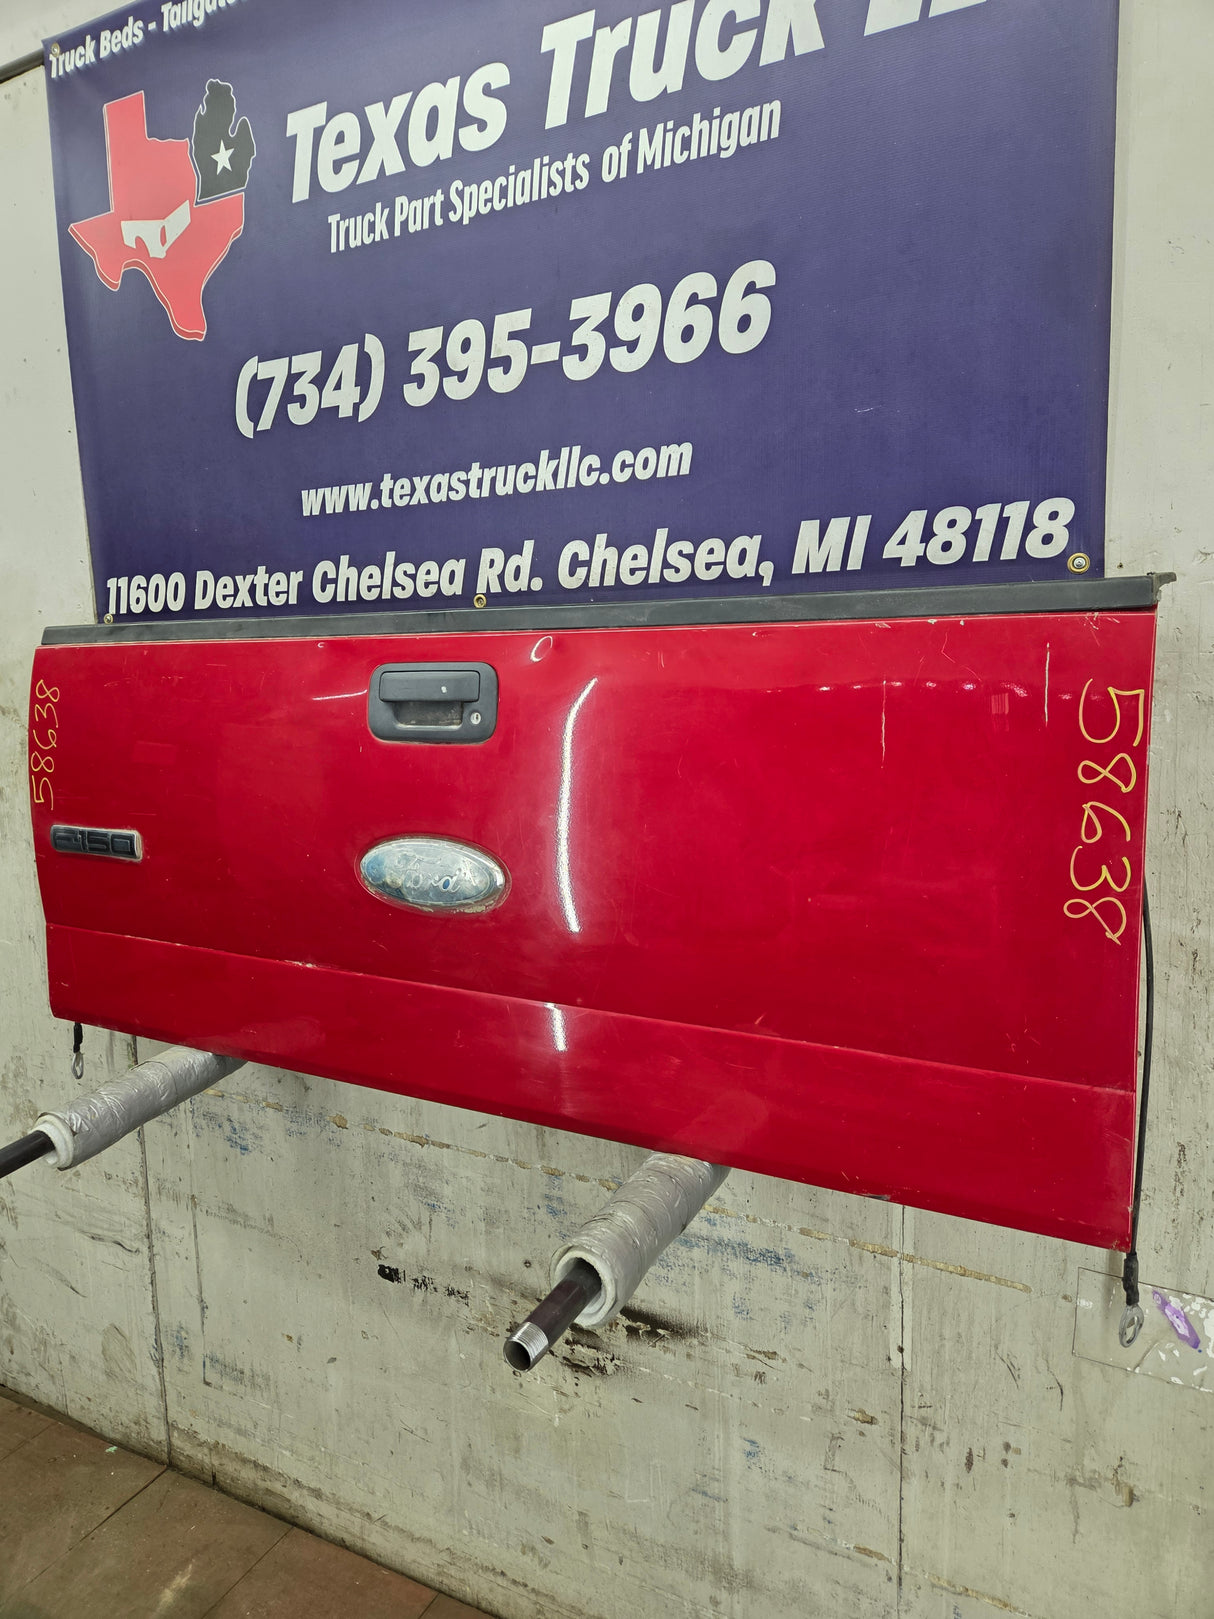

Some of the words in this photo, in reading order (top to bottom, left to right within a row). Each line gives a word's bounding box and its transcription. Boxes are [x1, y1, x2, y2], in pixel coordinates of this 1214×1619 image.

[49, 35, 97, 79] Truck
[100, 16, 143, 58] Beds
[286, 62, 510, 203] Texas
[540, 0, 825, 130] Truck
[328, 201, 389, 253] Truck
[394, 188, 444, 238] Part
[448, 153, 590, 225] Specialists
[602, 131, 632, 182] of
[637, 100, 781, 174] Michigan
[236, 333, 385, 438] (734)
[404, 260, 776, 406] 395-3966
[302, 442, 692, 516] www.texastruckllc.com
[107, 571, 185, 614] 11600
[195, 566, 303, 610] Dexter
[313, 551, 466, 604] Chelsea
[476, 540, 542, 594] Rd.
[558, 528, 774, 589] Chelsea,
[792, 515, 872, 574] MI
[883, 498, 1075, 567] 48118
[31, 679, 60, 810] 58638
[1063, 678, 1145, 946] 58638
